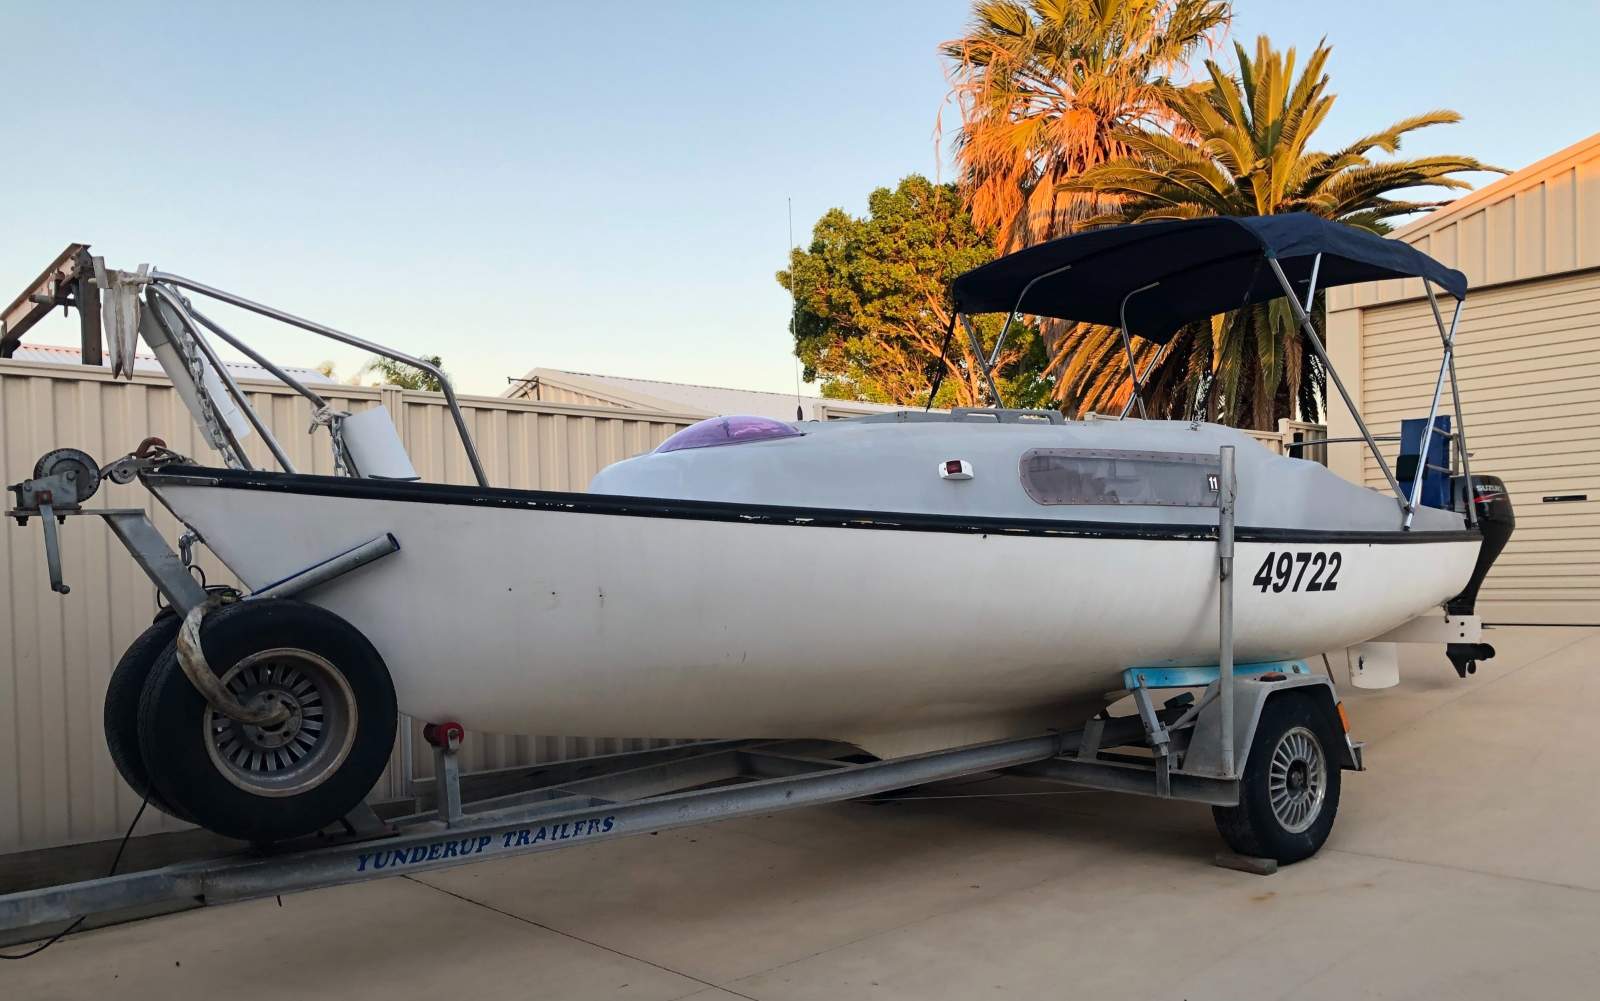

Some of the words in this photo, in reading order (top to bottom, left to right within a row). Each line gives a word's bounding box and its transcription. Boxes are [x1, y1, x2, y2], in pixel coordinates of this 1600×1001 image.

[1208, 476, 1218, 490] 11
[1252, 551, 1342, 593] 49722
[357, 836, 491, 872] YUNDERUP
